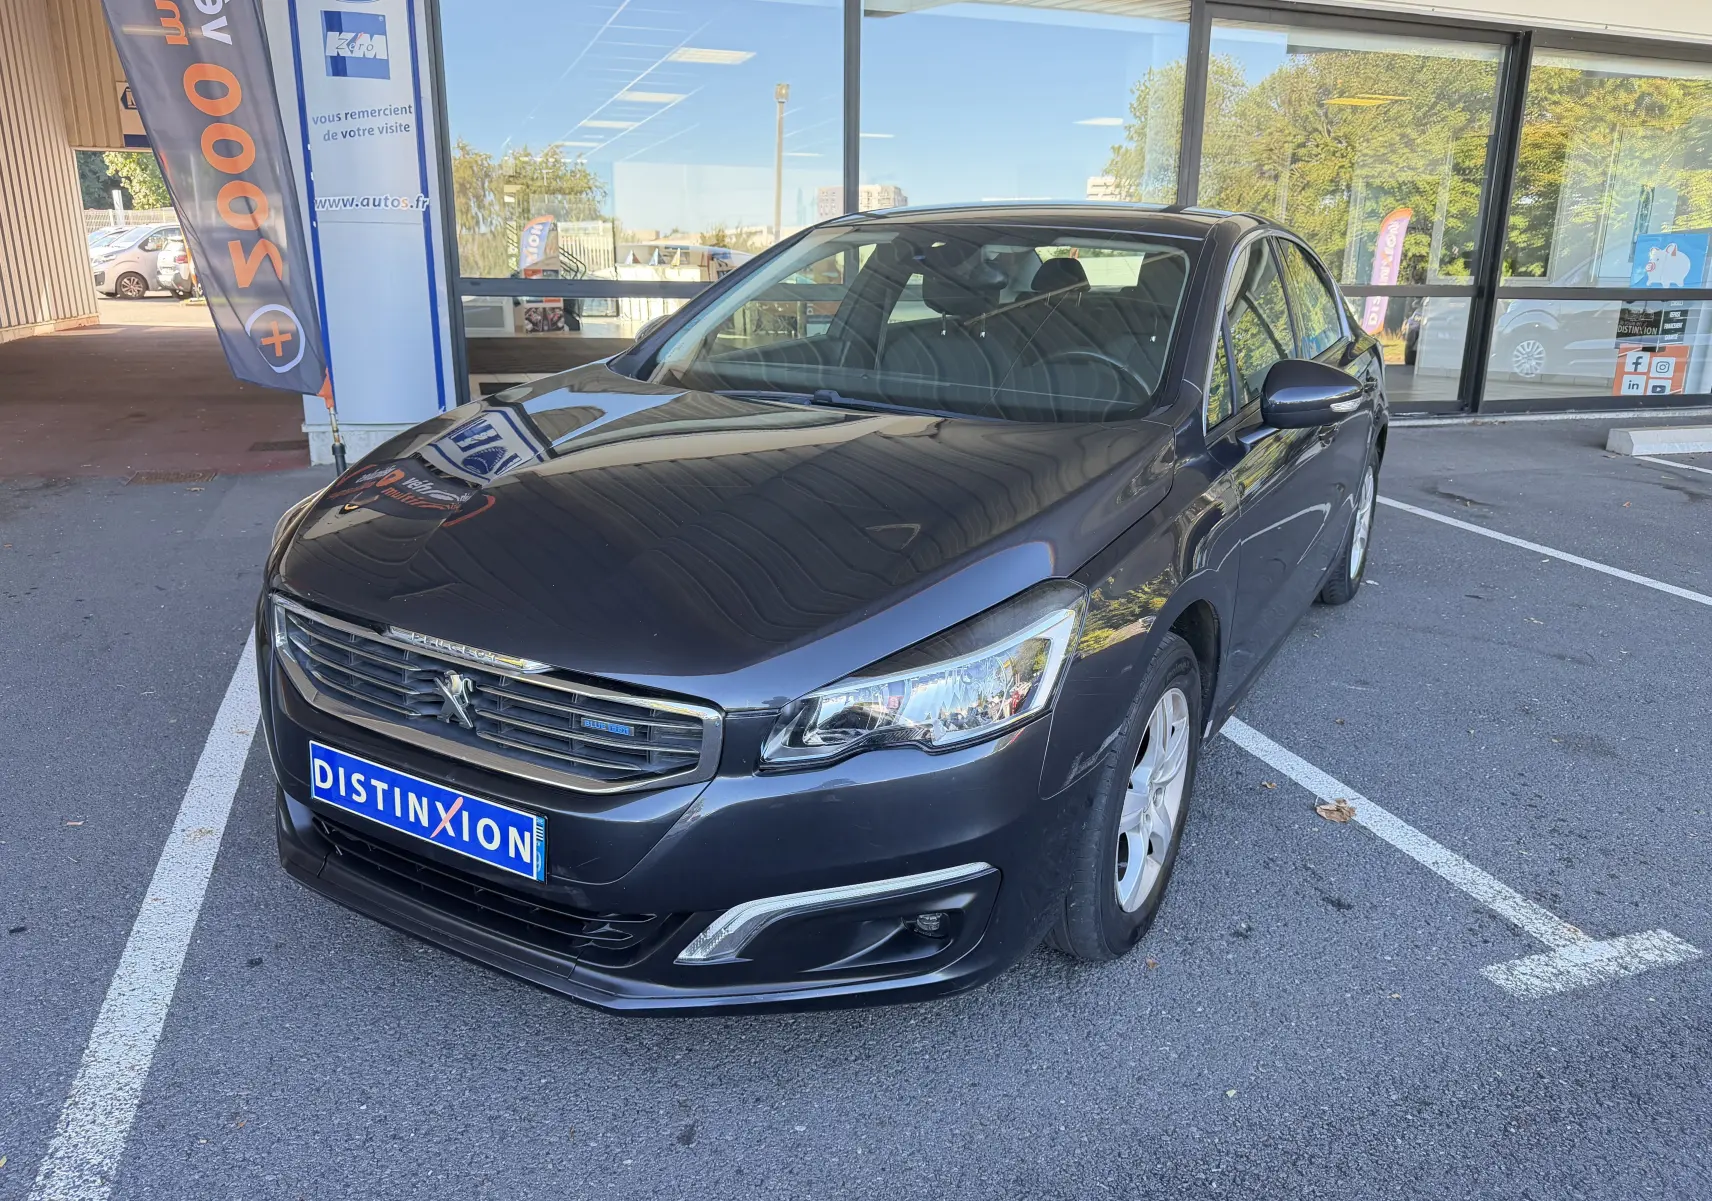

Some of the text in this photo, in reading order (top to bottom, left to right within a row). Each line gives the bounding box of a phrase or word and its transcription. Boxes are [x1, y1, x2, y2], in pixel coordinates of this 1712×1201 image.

[312, 104, 413, 126] vous remercient
[323, 121, 411, 142] de votre visite
[314, 194, 430, 210] www.autos.fr
[1369, 221, 1399, 325] DISINXION
[1617, 325, 1658, 335] DISTINXION
[314, 757, 531, 864] DISTINXION
